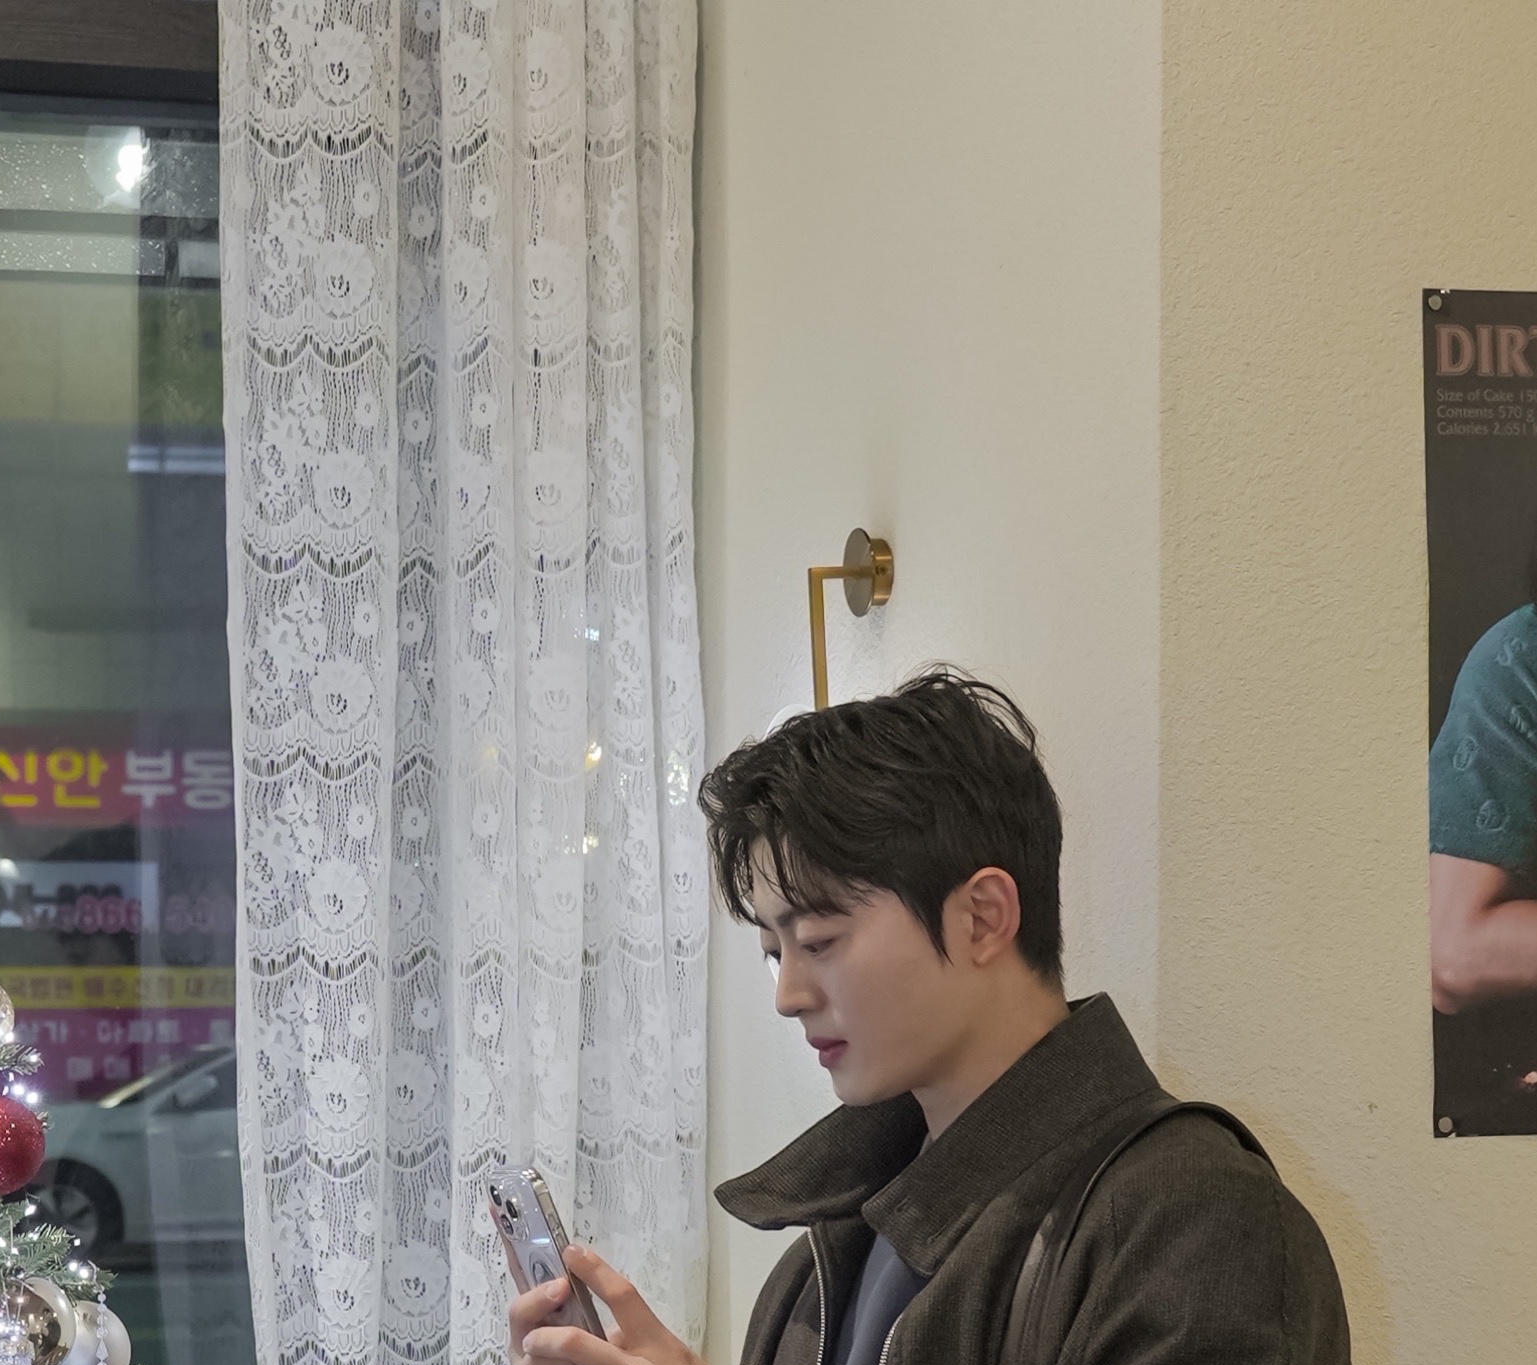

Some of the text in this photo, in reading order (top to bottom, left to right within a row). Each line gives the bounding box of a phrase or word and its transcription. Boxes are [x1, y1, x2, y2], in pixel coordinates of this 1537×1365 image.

[1435, 324, 1537, 376] DIR
[1437, 388, 1463, 401] Size
[1467, 388, 1480, 401] of
[1483, 389, 1514, 402] Cake
[1437, 405, 1494, 419] Contents
[1499, 406, 1522, 419] 570
[1437, 421, 1489, 436] Calories
